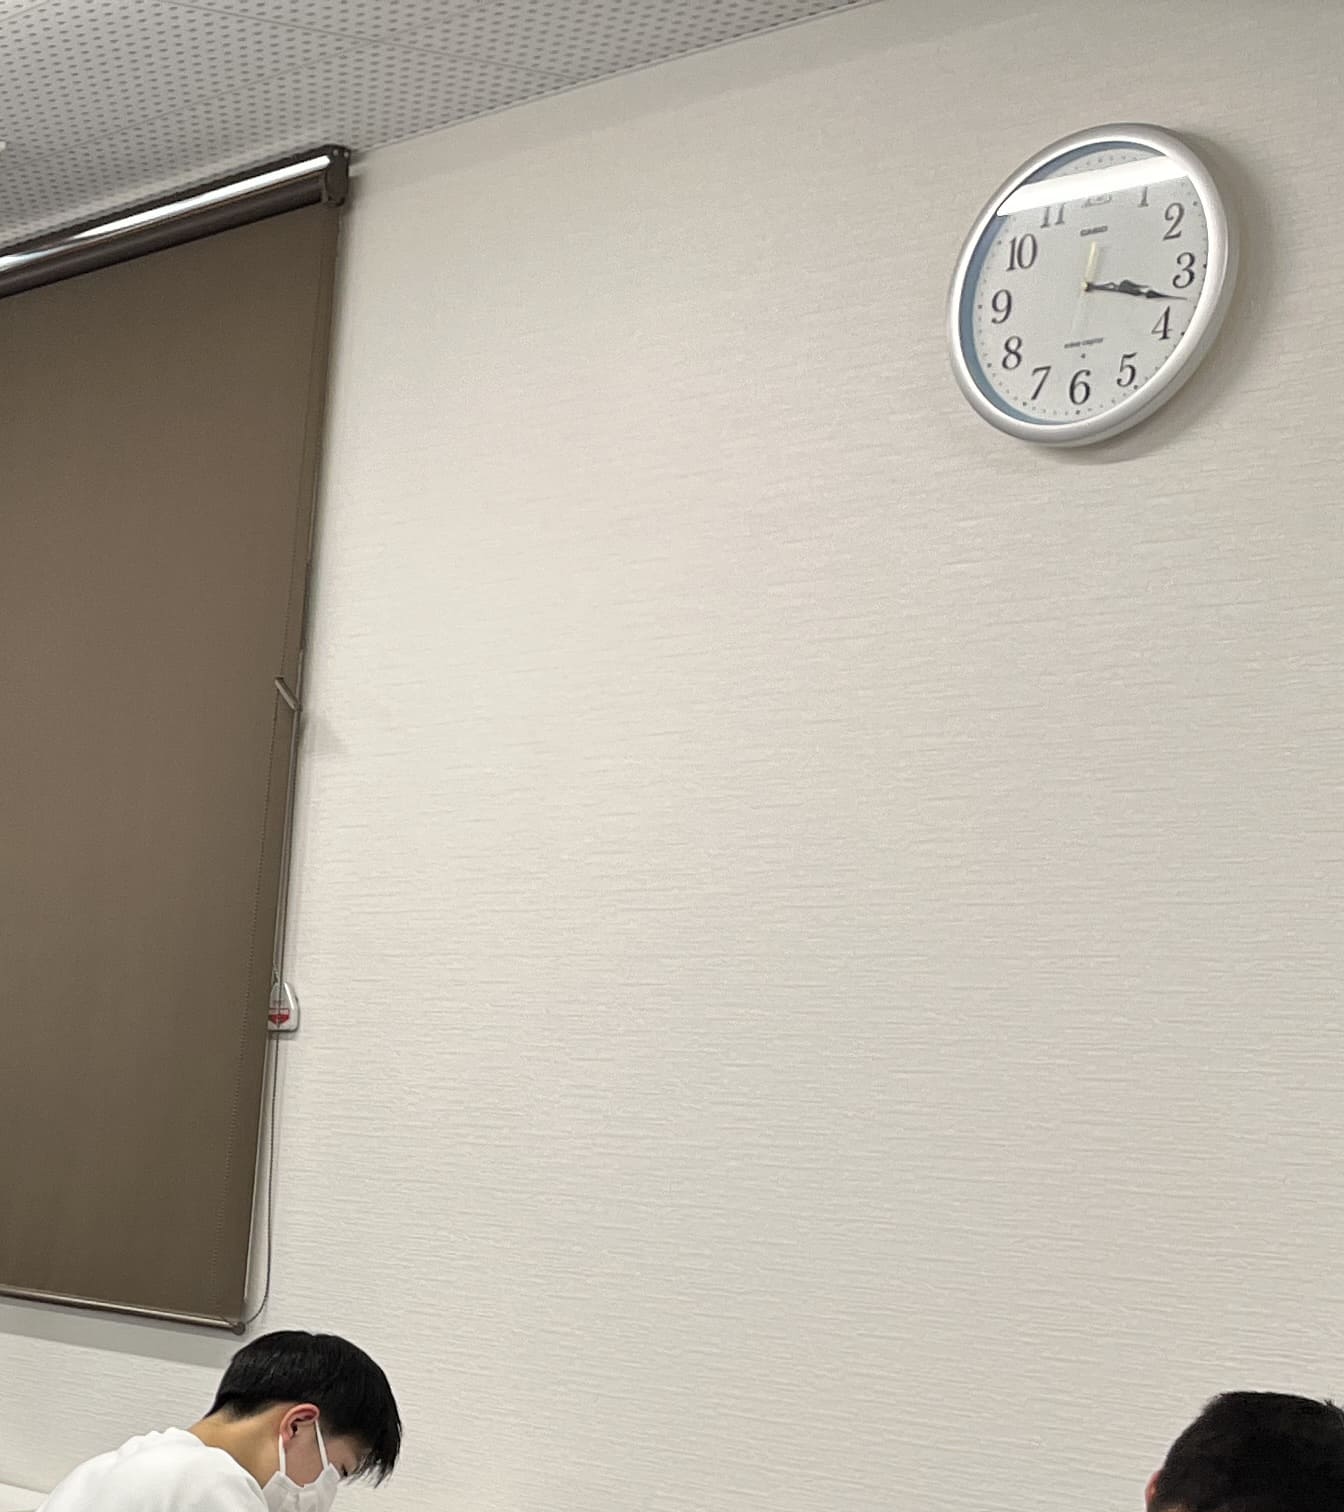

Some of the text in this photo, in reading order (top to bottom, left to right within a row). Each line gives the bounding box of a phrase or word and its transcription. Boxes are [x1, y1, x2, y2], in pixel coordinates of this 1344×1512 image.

[1163, 202, 1185, 240] 2
[1006, 233, 1037, 271] 10
[1173, 252, 1195, 288] 3
[991, 289, 1012, 324] 9
[1151, 306, 1173, 341] 4
[1002, 336, 1022, 370] 8
[1116, 352, 1138, 387] 5
[1030, 366, 1051, 400] 7
[1069, 369, 1091, 405] 6
